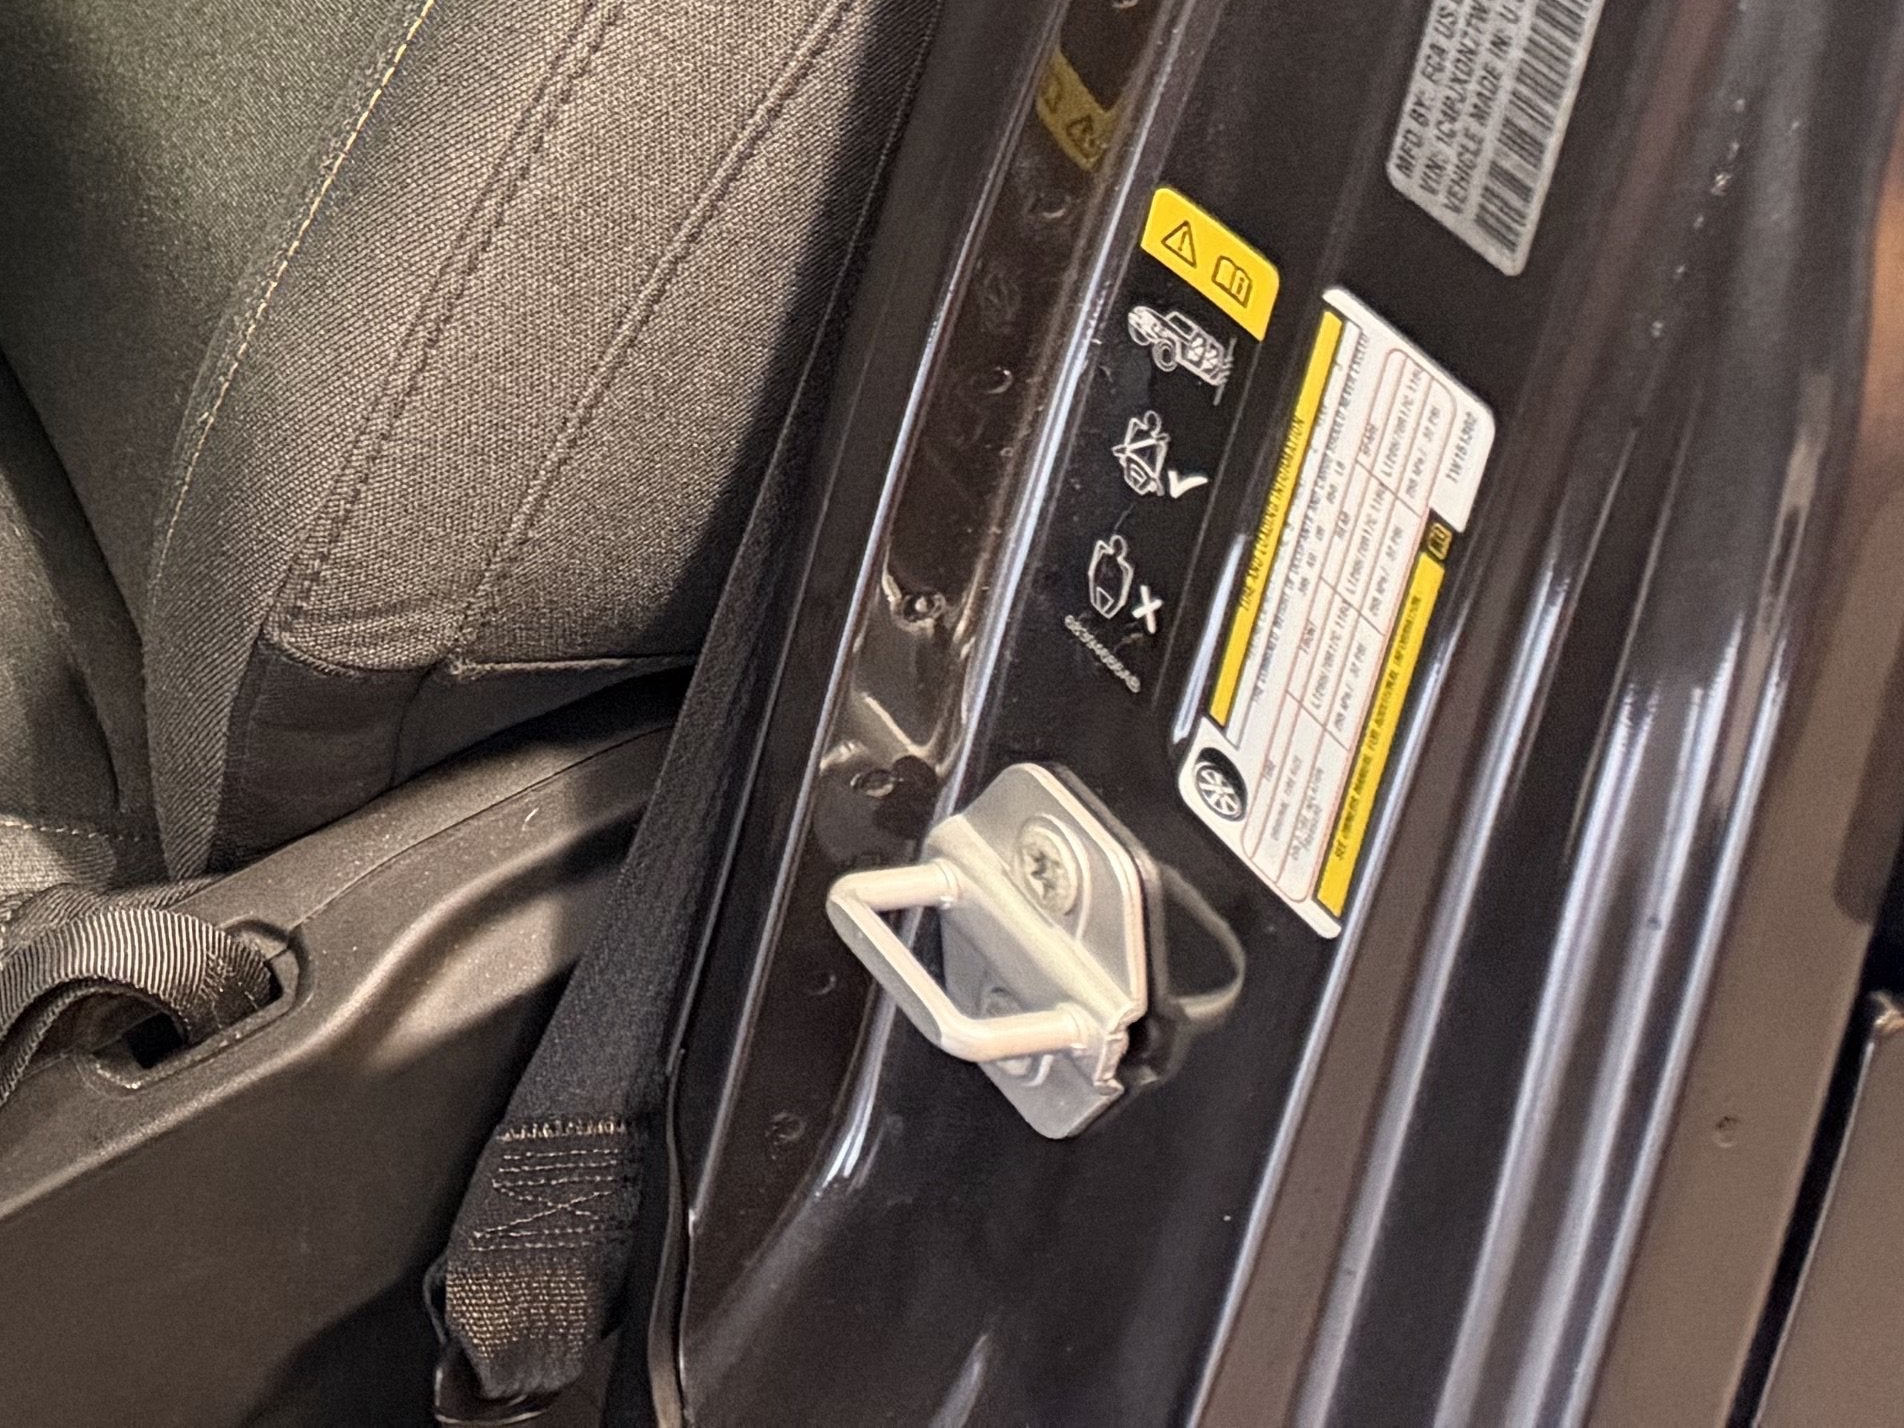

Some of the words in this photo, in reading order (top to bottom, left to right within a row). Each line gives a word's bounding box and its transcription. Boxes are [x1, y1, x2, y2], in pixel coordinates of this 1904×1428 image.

[1434, 6, 1456, 38] US
[1422, 41, 1447, 84] FCA
[1396, 129, 1422, 179] MFD
[1445, 128, 1482, 216] VEHICLE
[1470, 63, 1501, 126] MADE
[1421, 151, 1446, 196] VIN:
